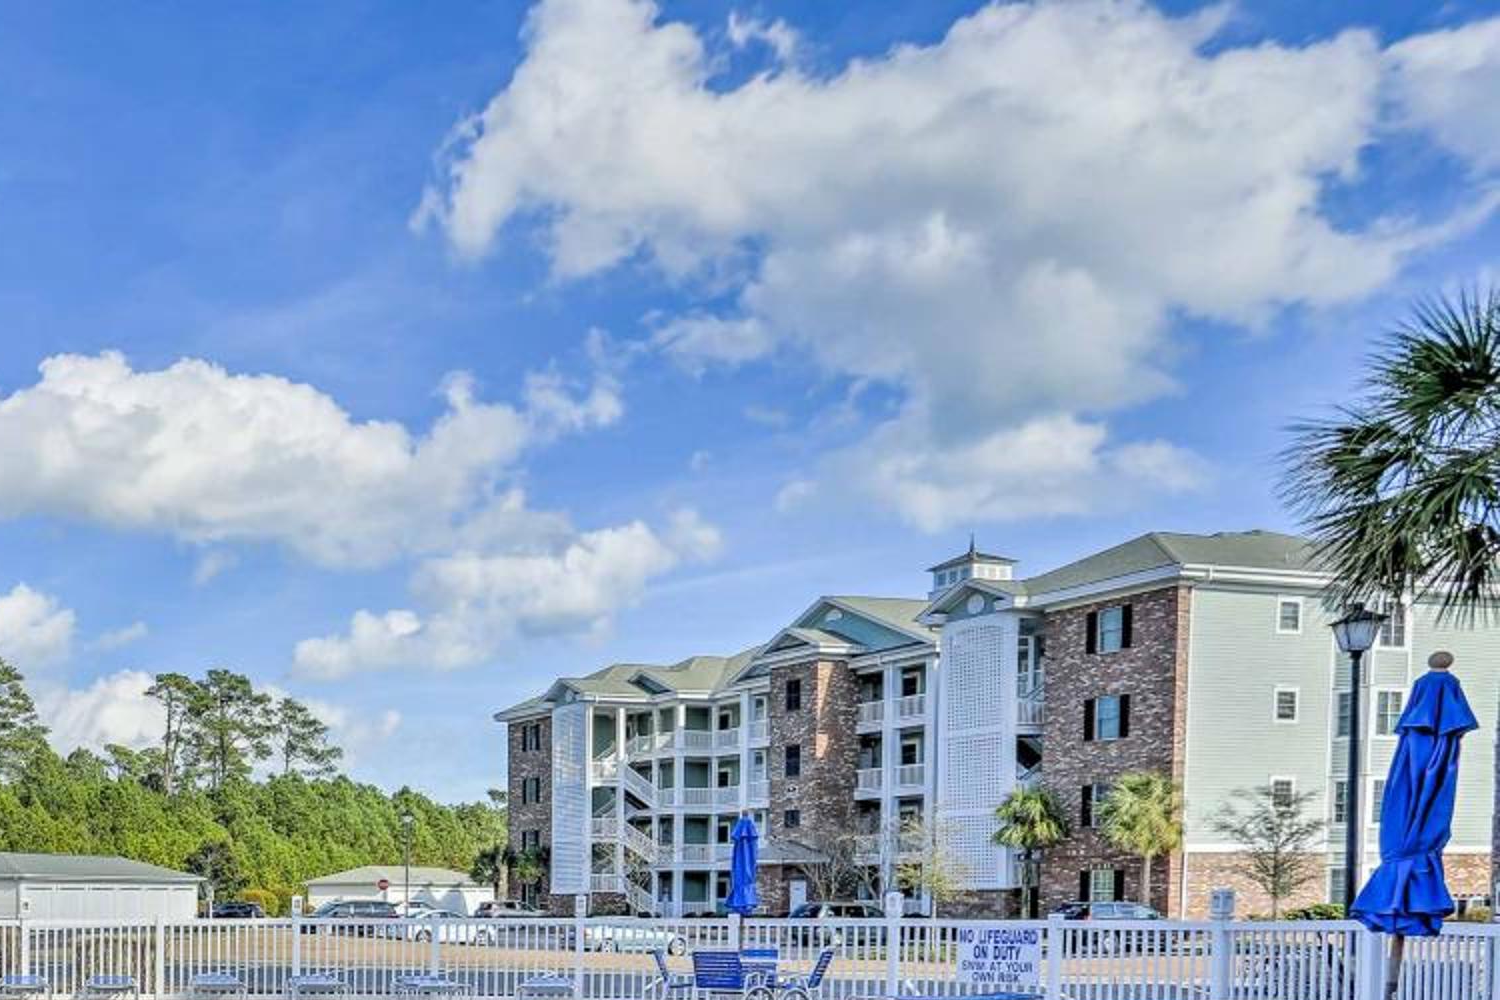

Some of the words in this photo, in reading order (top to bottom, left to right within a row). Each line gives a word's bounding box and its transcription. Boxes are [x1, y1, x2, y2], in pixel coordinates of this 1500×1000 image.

[960, 929, 974, 943] NO
[979, 929, 1038, 944] LIFEGUARD
[973, 945, 988, 959] ON
[994, 946, 1021, 960] DUTY
[990, 961, 1003, 971] AT
[1006, 962, 1032, 973] YOUR
[971, 972, 994, 982] OWN
[998, 973, 1020, 983] RISK
